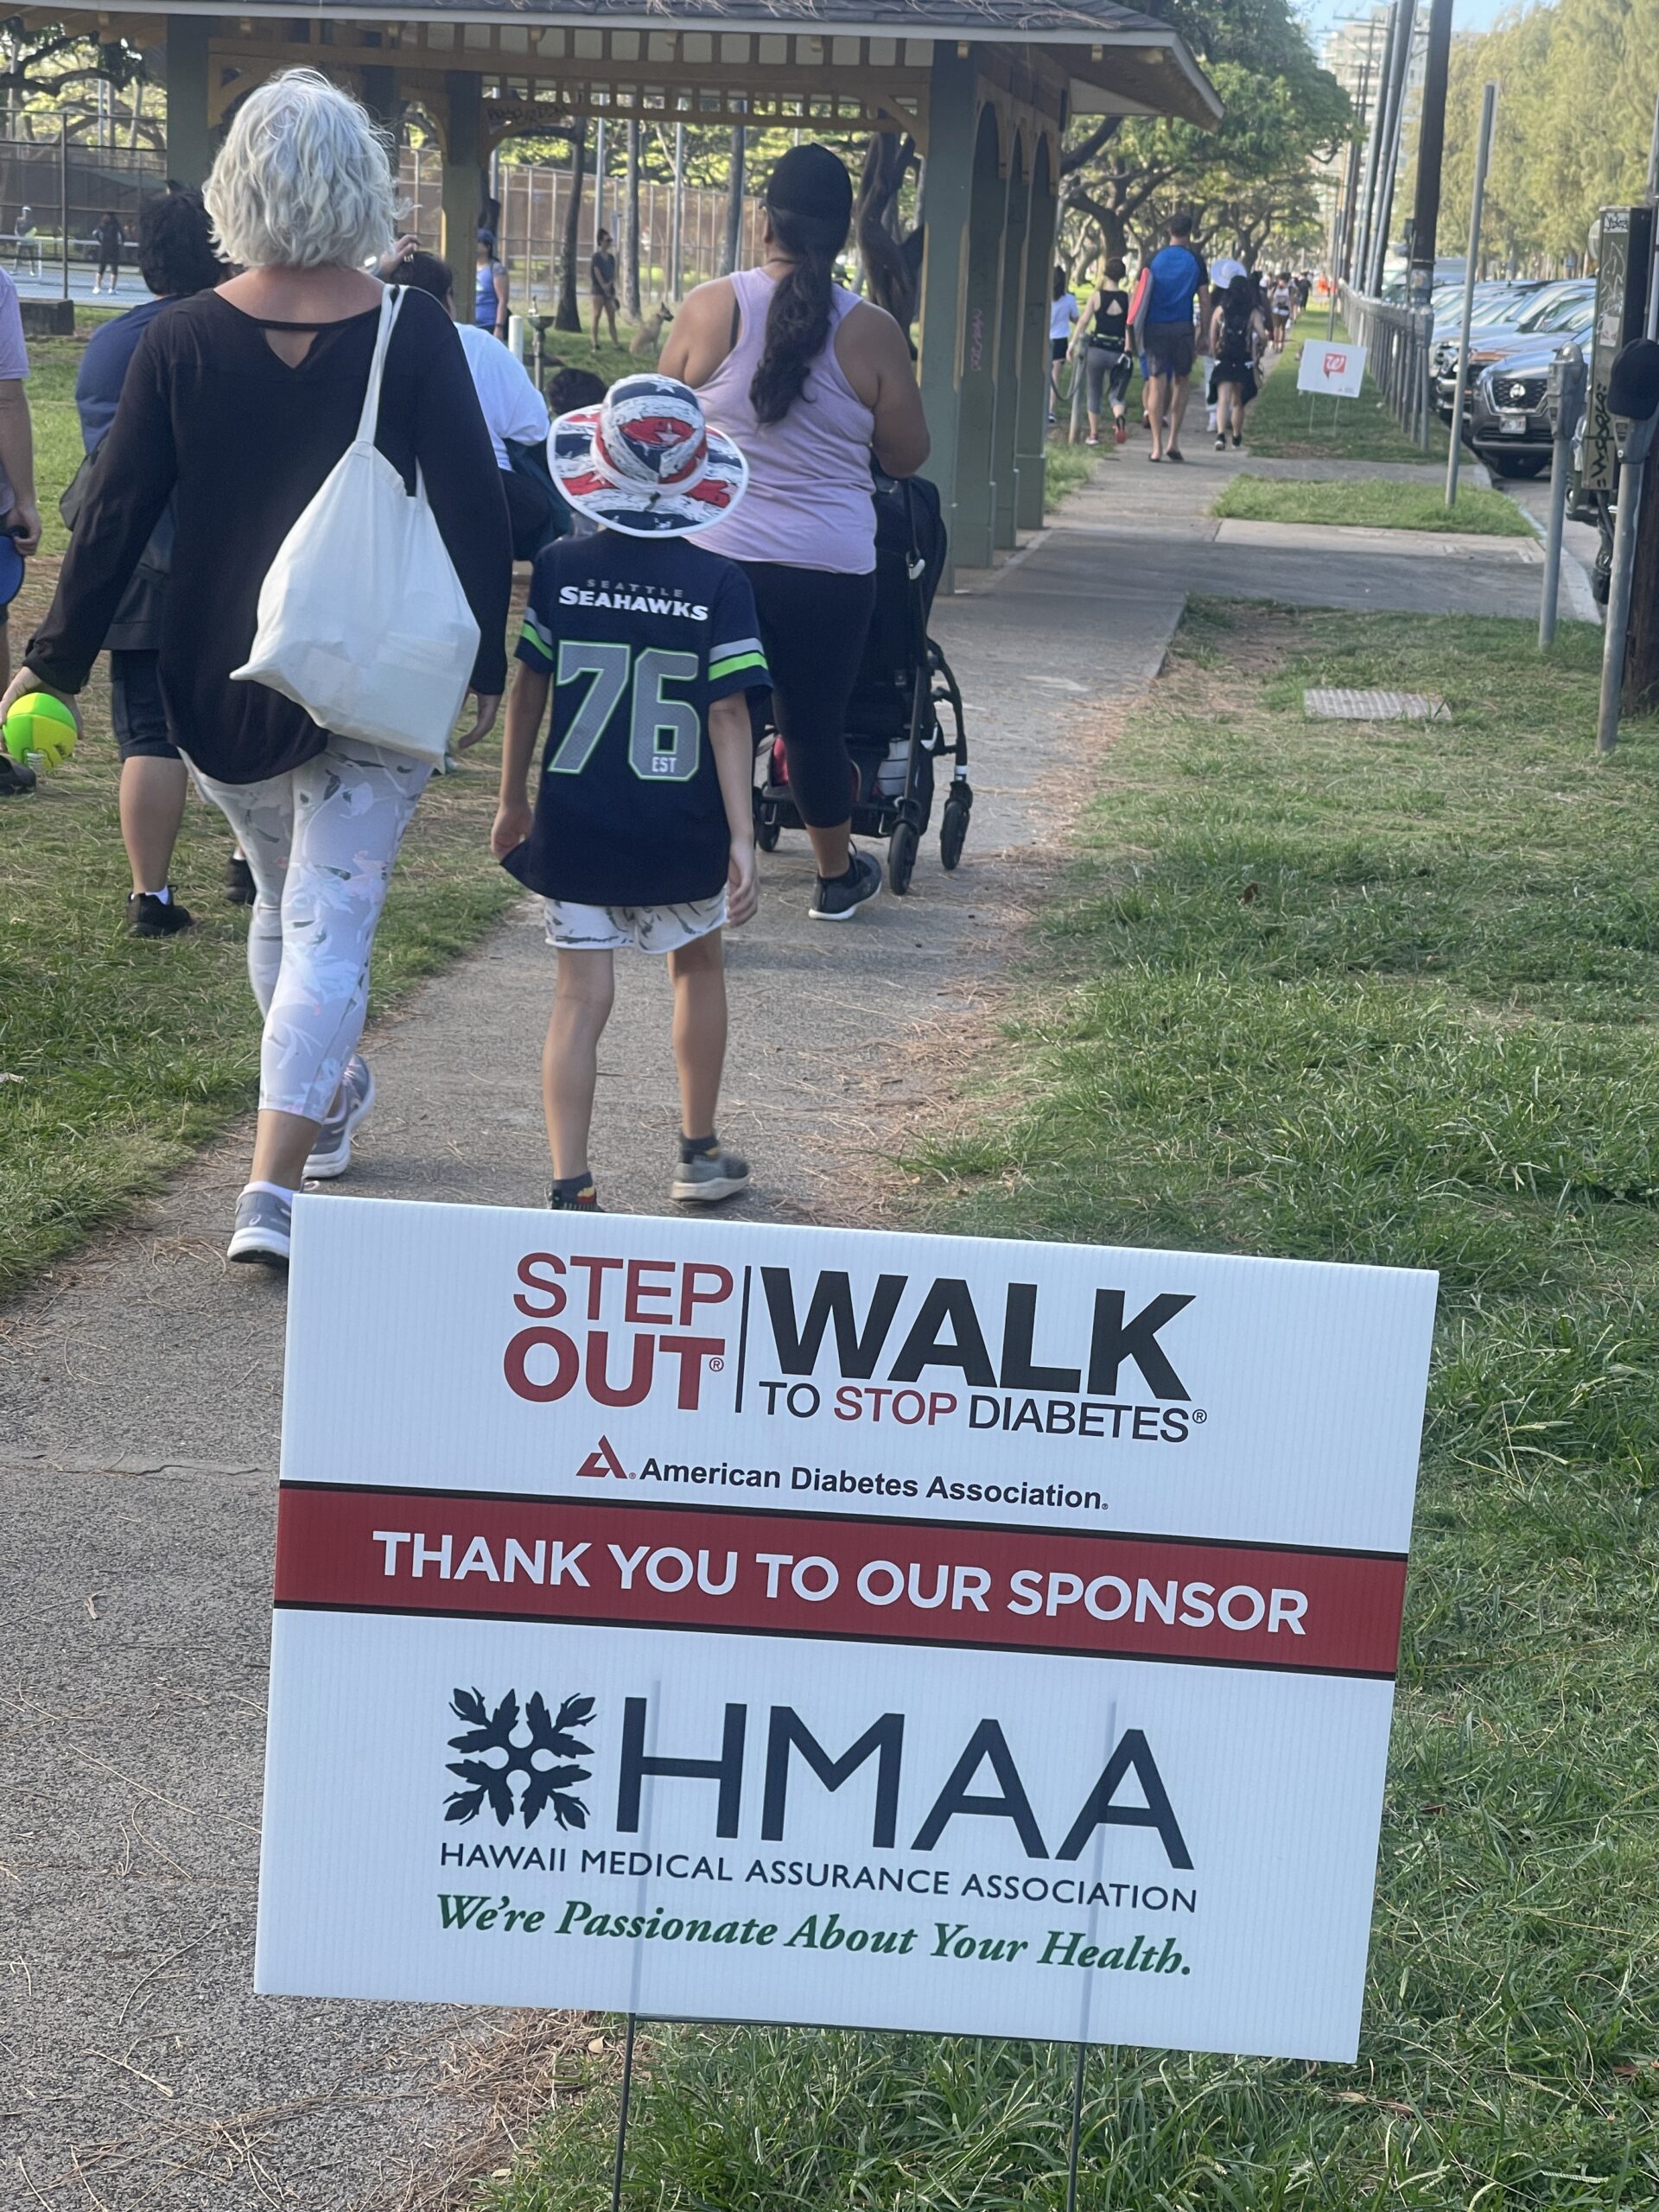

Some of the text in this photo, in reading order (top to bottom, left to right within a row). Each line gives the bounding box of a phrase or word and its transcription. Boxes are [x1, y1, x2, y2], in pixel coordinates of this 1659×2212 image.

[559, 586, 709, 621] SEAHAWKS
[587, 578, 683, 598] SEATTLE
[548, 640, 700, 782] 76
[652, 756, 677, 773] EST
[513, 1252, 734, 1326] STEP
[760, 1266, 1197, 1402] WALK
[759, 1381, 821, 1419] TO
[833, 1385, 957, 1426] STOP
[639, 1458, 781, 1489] American
[791, 1466, 918, 1497] Diabetes
[372, 1530, 1308, 1635] THANK YOU TO OUR SPONSOR
[616, 1696, 1195, 1871] HMAA
[441, 1842, 1197, 1913] HAWAII MEDICAL ASSURANCE ASSOCIATION
[436, 1893, 1191, 1976] We're Passionate About Your Health.
